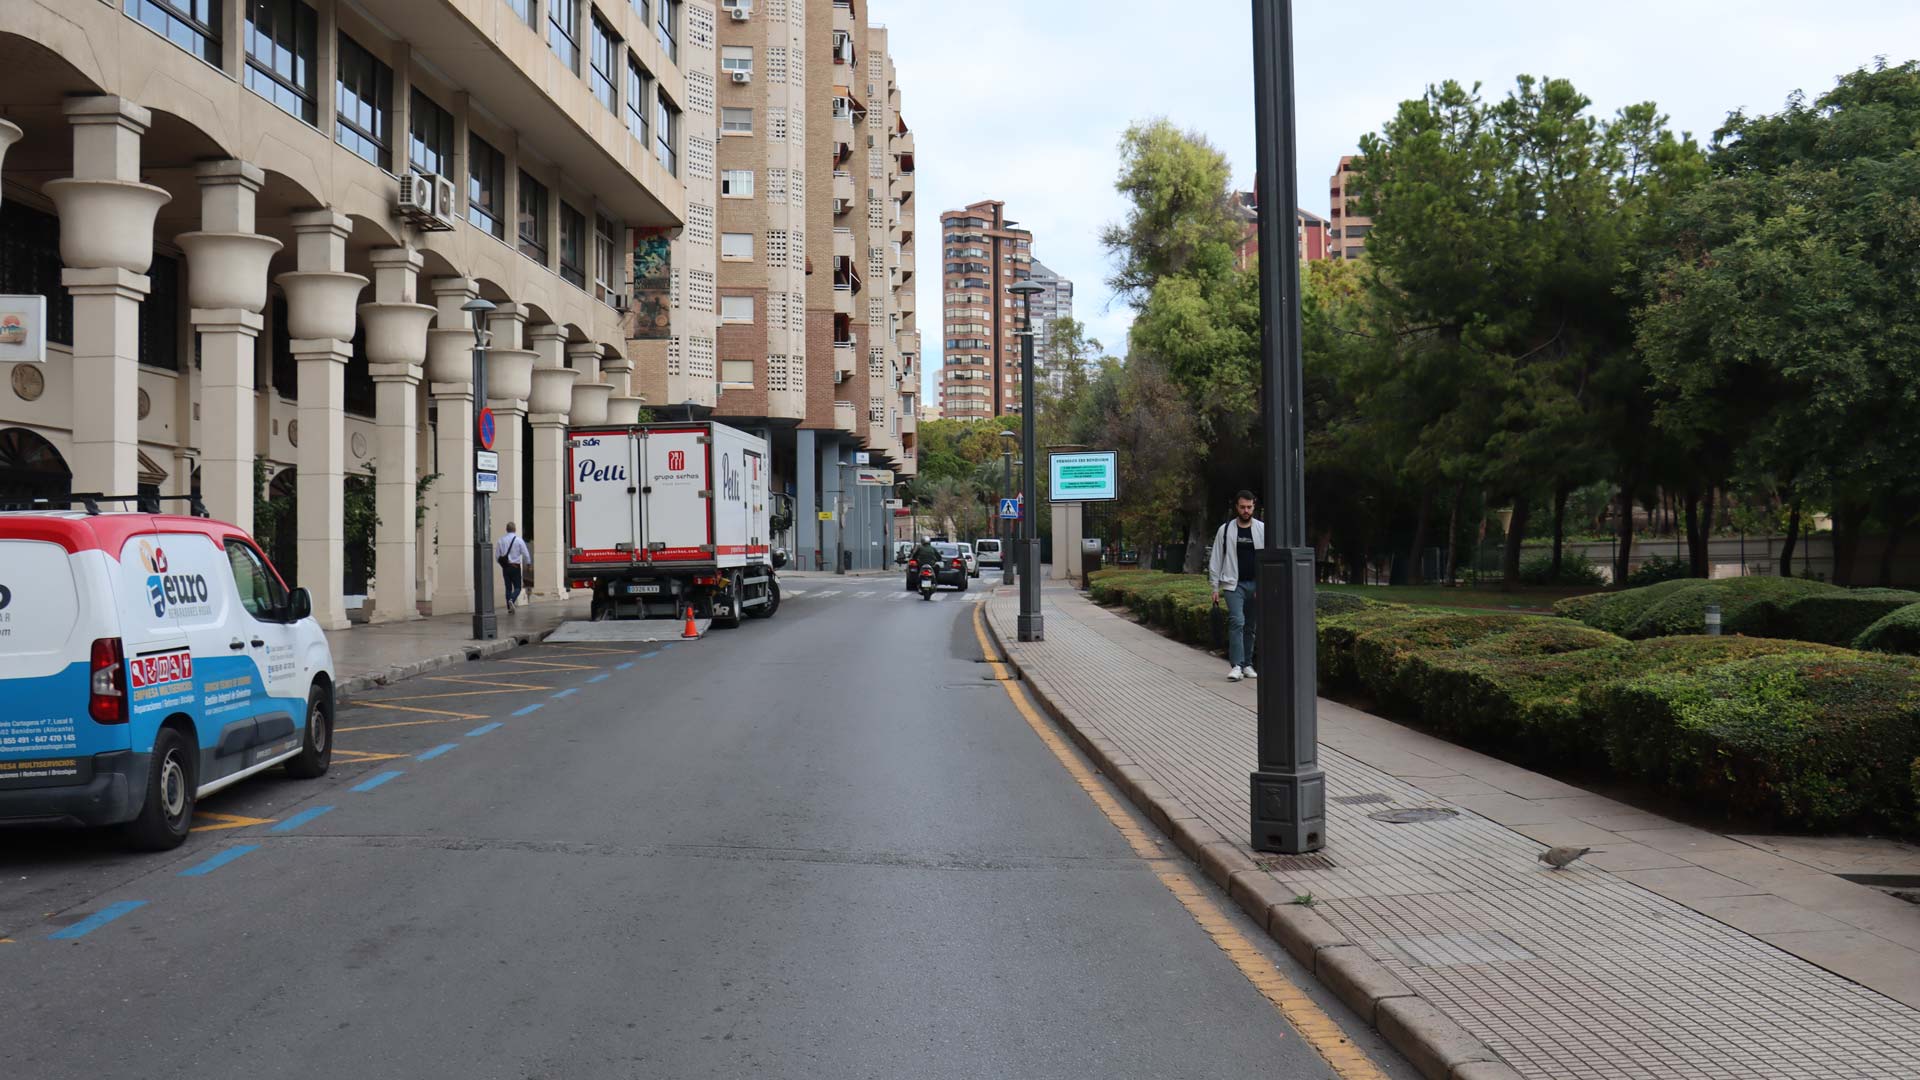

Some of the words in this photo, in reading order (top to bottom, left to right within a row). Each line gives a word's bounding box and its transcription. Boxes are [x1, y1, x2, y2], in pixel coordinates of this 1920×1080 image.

[578, 459, 627, 482] Pelli
[722, 452, 740, 501] Pelli
[163, 574, 208, 605] euro
